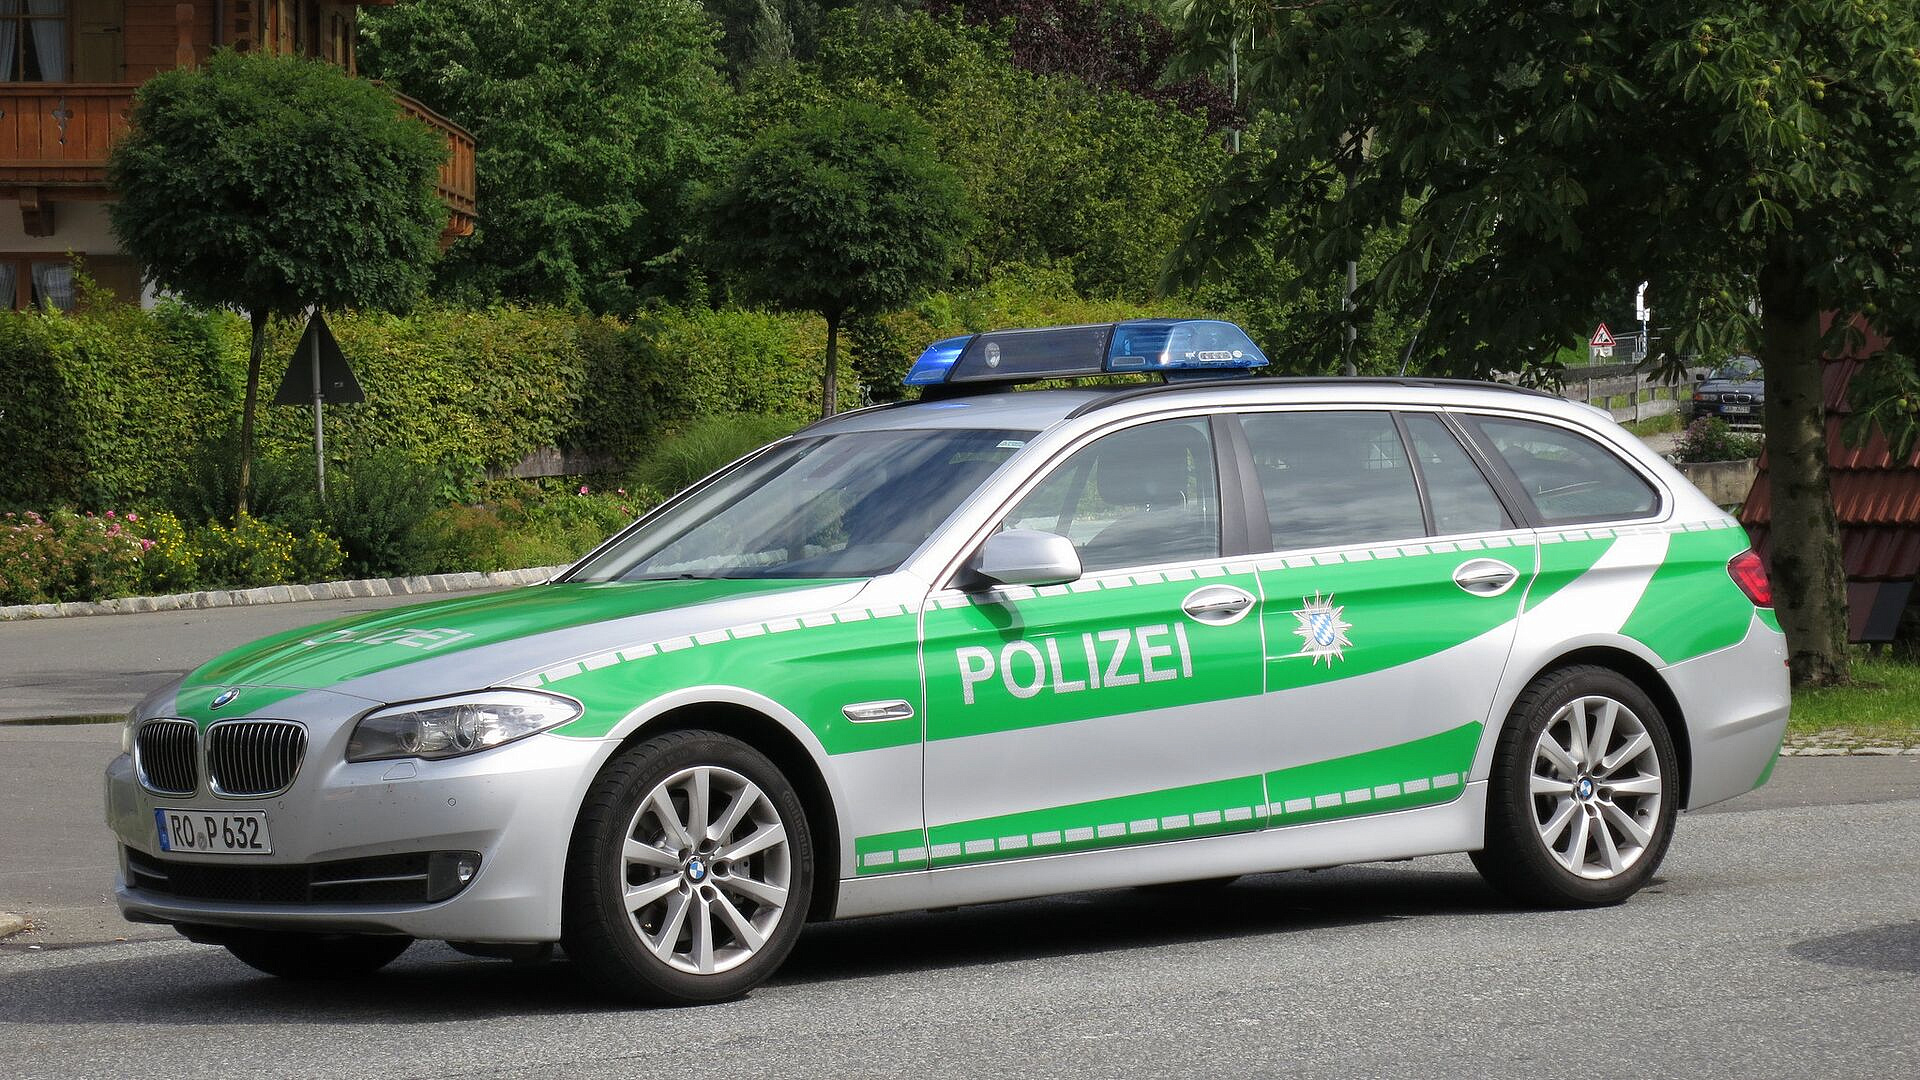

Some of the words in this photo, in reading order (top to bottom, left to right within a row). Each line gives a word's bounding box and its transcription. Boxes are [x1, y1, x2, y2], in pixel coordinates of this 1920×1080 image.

[955, 622, 1193, 705] POLIZEI
[171, 815, 195, 848] RO
[204, 816, 217, 848] P
[223, 817, 262, 849] 632
